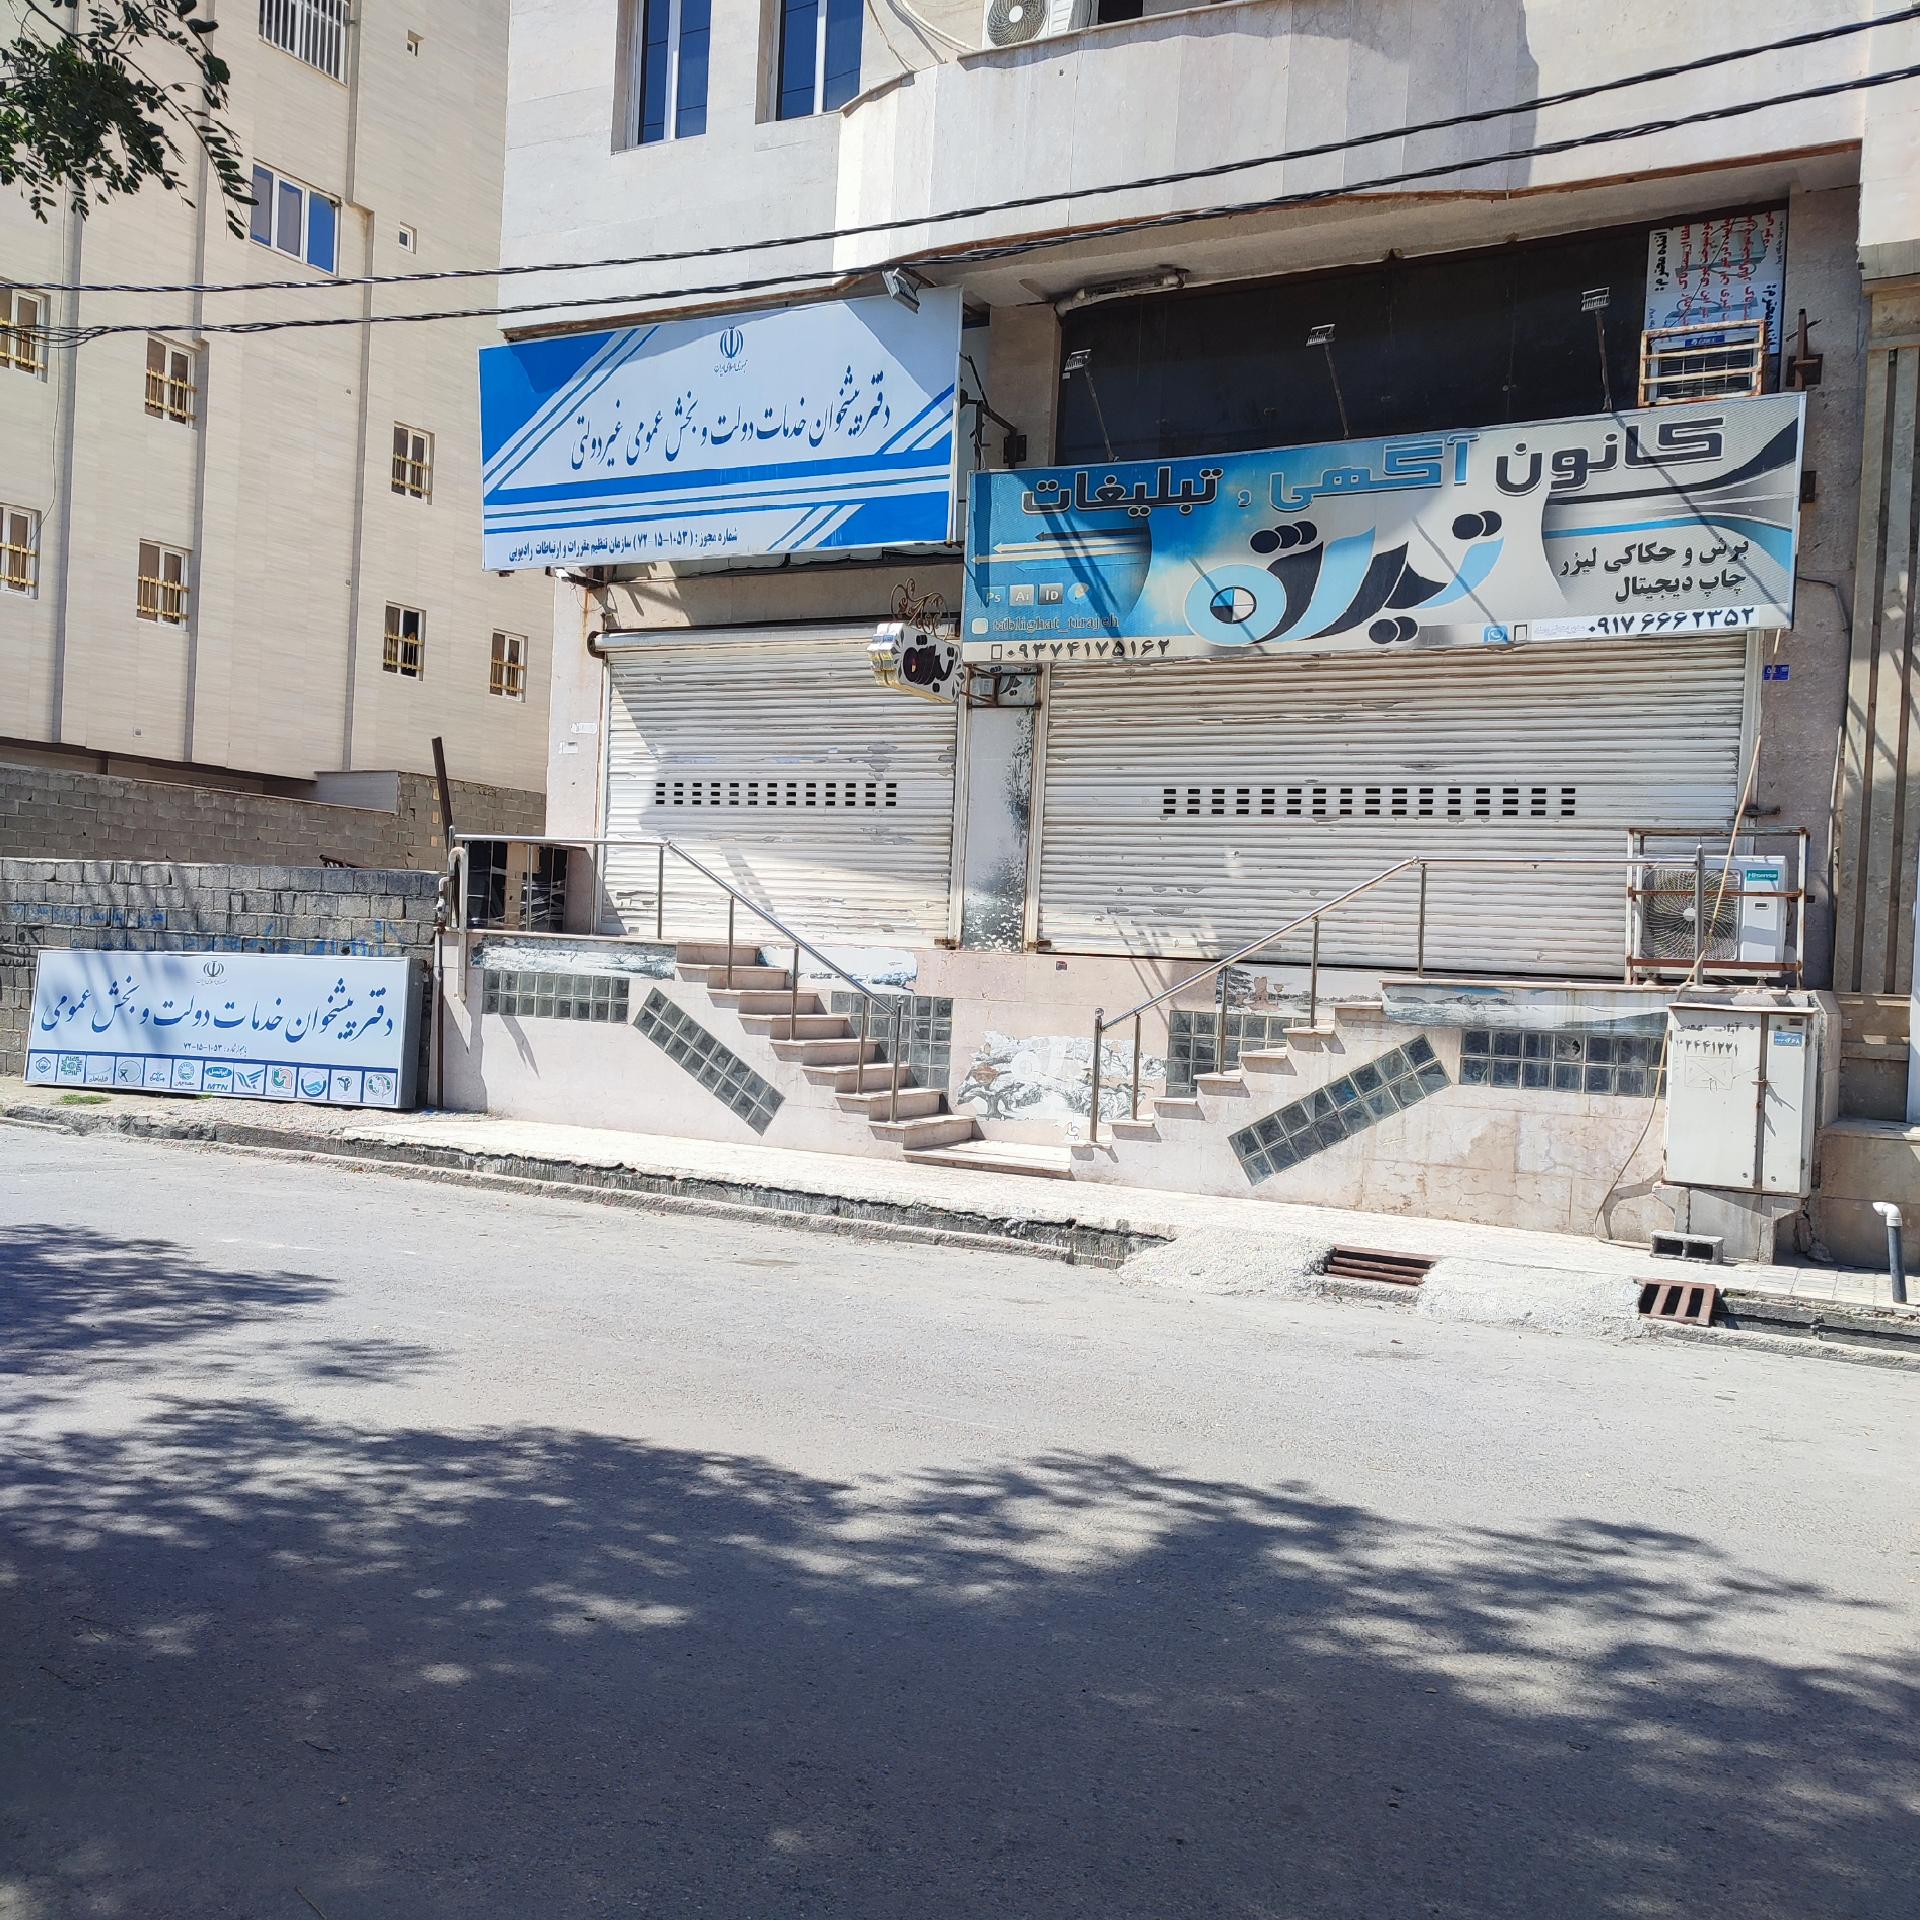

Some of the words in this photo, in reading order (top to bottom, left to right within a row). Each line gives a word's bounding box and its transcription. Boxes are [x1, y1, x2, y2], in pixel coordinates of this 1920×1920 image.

[756, 396, 807, 440] خدمات
[808, 364, 861, 448] پیشخوان
[856, 369, 890, 439] دفتر
[626, 410, 663, 466] عمومی
[665, 390, 699, 462] بخش
[700, 425, 708, 447] و
[710, 404, 754, 445] دولت
[1268, 433, 1480, 512] آگهی
[1495, 415, 1726, 497] کانون
[1021, 465, 1224, 517] تبلیغات
[535, 539, 561, 560] ارتباطات
[567, 539, 590, 558] مقررات
[591, 537, 608, 556] تنظیم
[609, 535, 631, 554] سازمان
[718, 527, 738, 542] شماره
[1559, 546, 1597, 576] لیزر
[1604, 541, 1676, 572] حکاکی
[1682, 546, 1693, 567] و
[1183, 510, 1504, 646] تیراژه
[1615, 575, 1693, 602] دیجیتال
[1699, 568, 1747, 598] چاپ
[986, 592, 1001, 603] Ps
[1015, 592, 1029, 602] Ai
[1006, 638, 1171, 659] ۰۹۳۷۴۱۷۵۱۶۲
[41, 988, 91, 1032] عمومی
[91, 975, 141, 1033] بخش
[139, 1007, 150, 1025] و
[153, 994, 210, 1027] دولت
[213, 998, 283, 1031] خدمات
[285, 977, 354, 1044] پیشخوان
[349, 986, 393, 1043] دفتر
[207, 1083, 229, 1091] MTN
